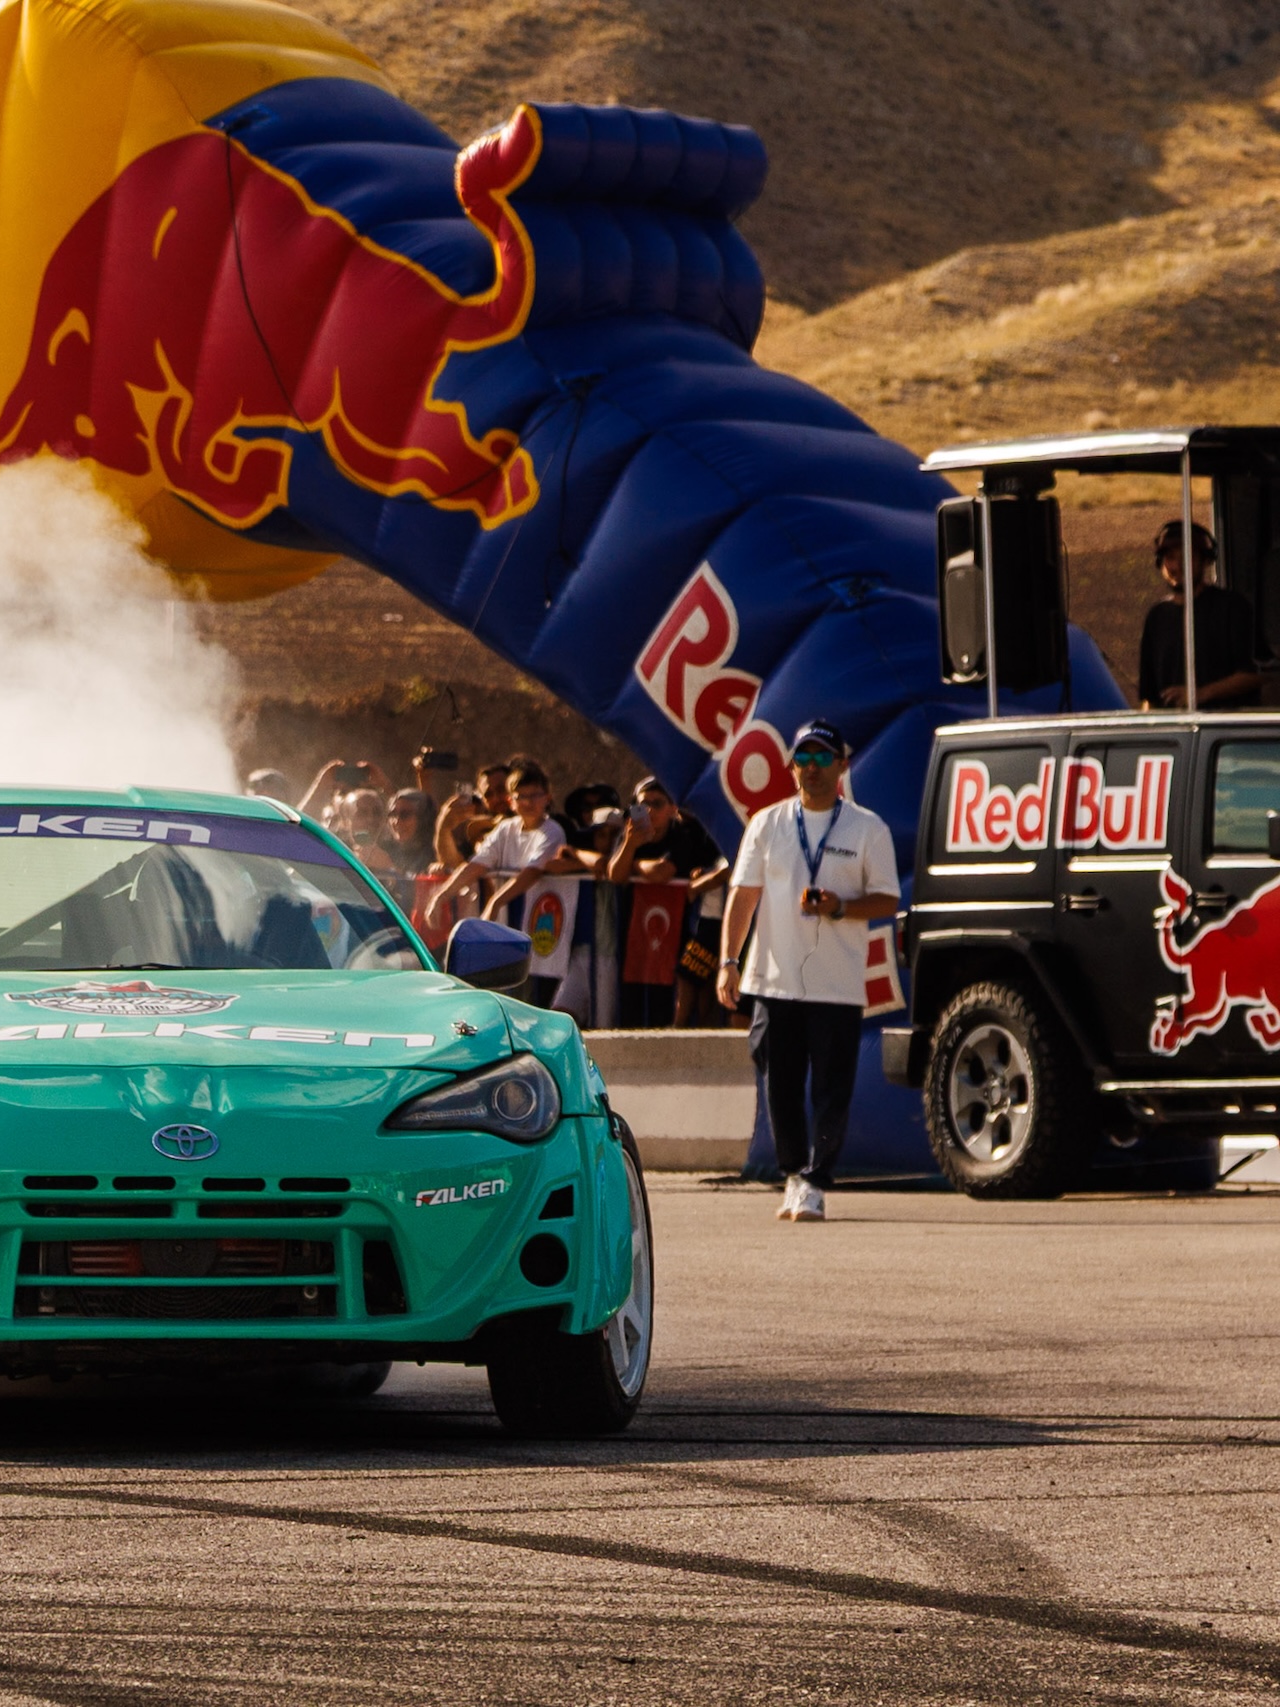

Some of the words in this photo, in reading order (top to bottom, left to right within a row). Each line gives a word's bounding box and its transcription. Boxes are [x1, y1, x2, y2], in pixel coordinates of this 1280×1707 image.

[947, 758, 1054, 850] Red
[1057, 757, 1172, 848] Bull
[415, 1179, 505, 1207] FALKEN
